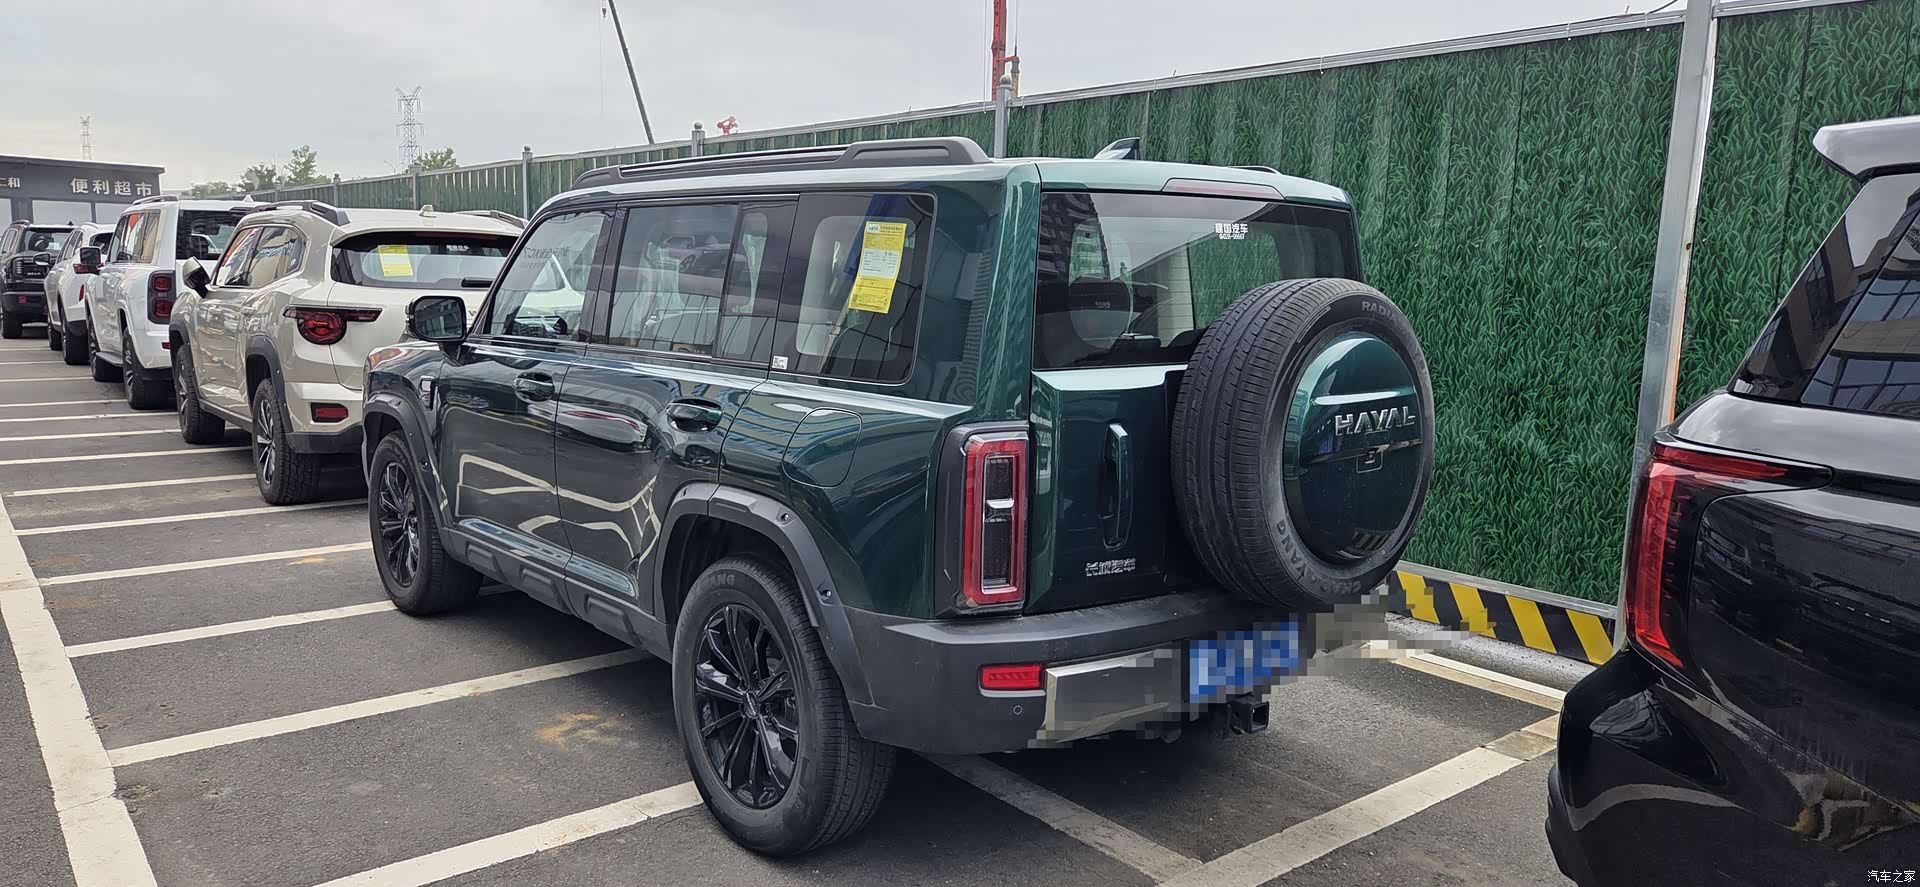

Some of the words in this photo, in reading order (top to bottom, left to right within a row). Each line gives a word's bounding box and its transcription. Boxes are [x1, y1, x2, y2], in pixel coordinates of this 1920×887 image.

[70, 178, 152, 197] 便利超市
[1334, 405, 1417, 437] HAVAL
